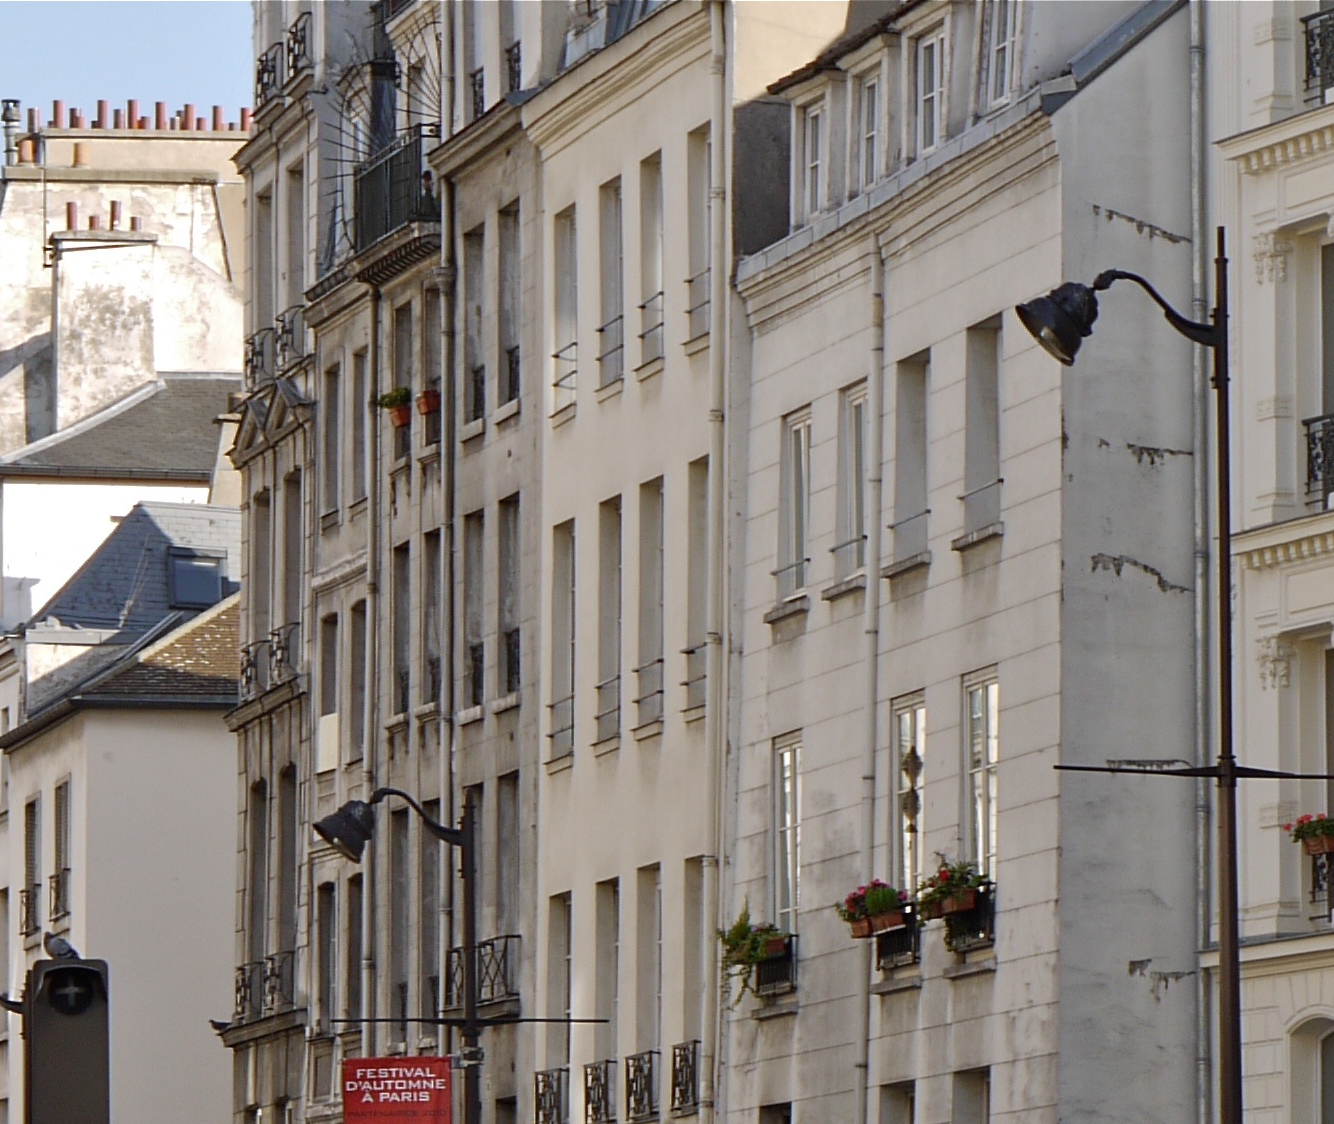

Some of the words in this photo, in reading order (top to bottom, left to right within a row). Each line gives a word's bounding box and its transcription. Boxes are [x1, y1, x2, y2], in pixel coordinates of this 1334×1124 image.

[356, 1067, 436, 1079] FESTIVAL
[345, 1079, 446, 1092] D'AUTOMNE
[379, 1091, 430, 1103] PARIS
